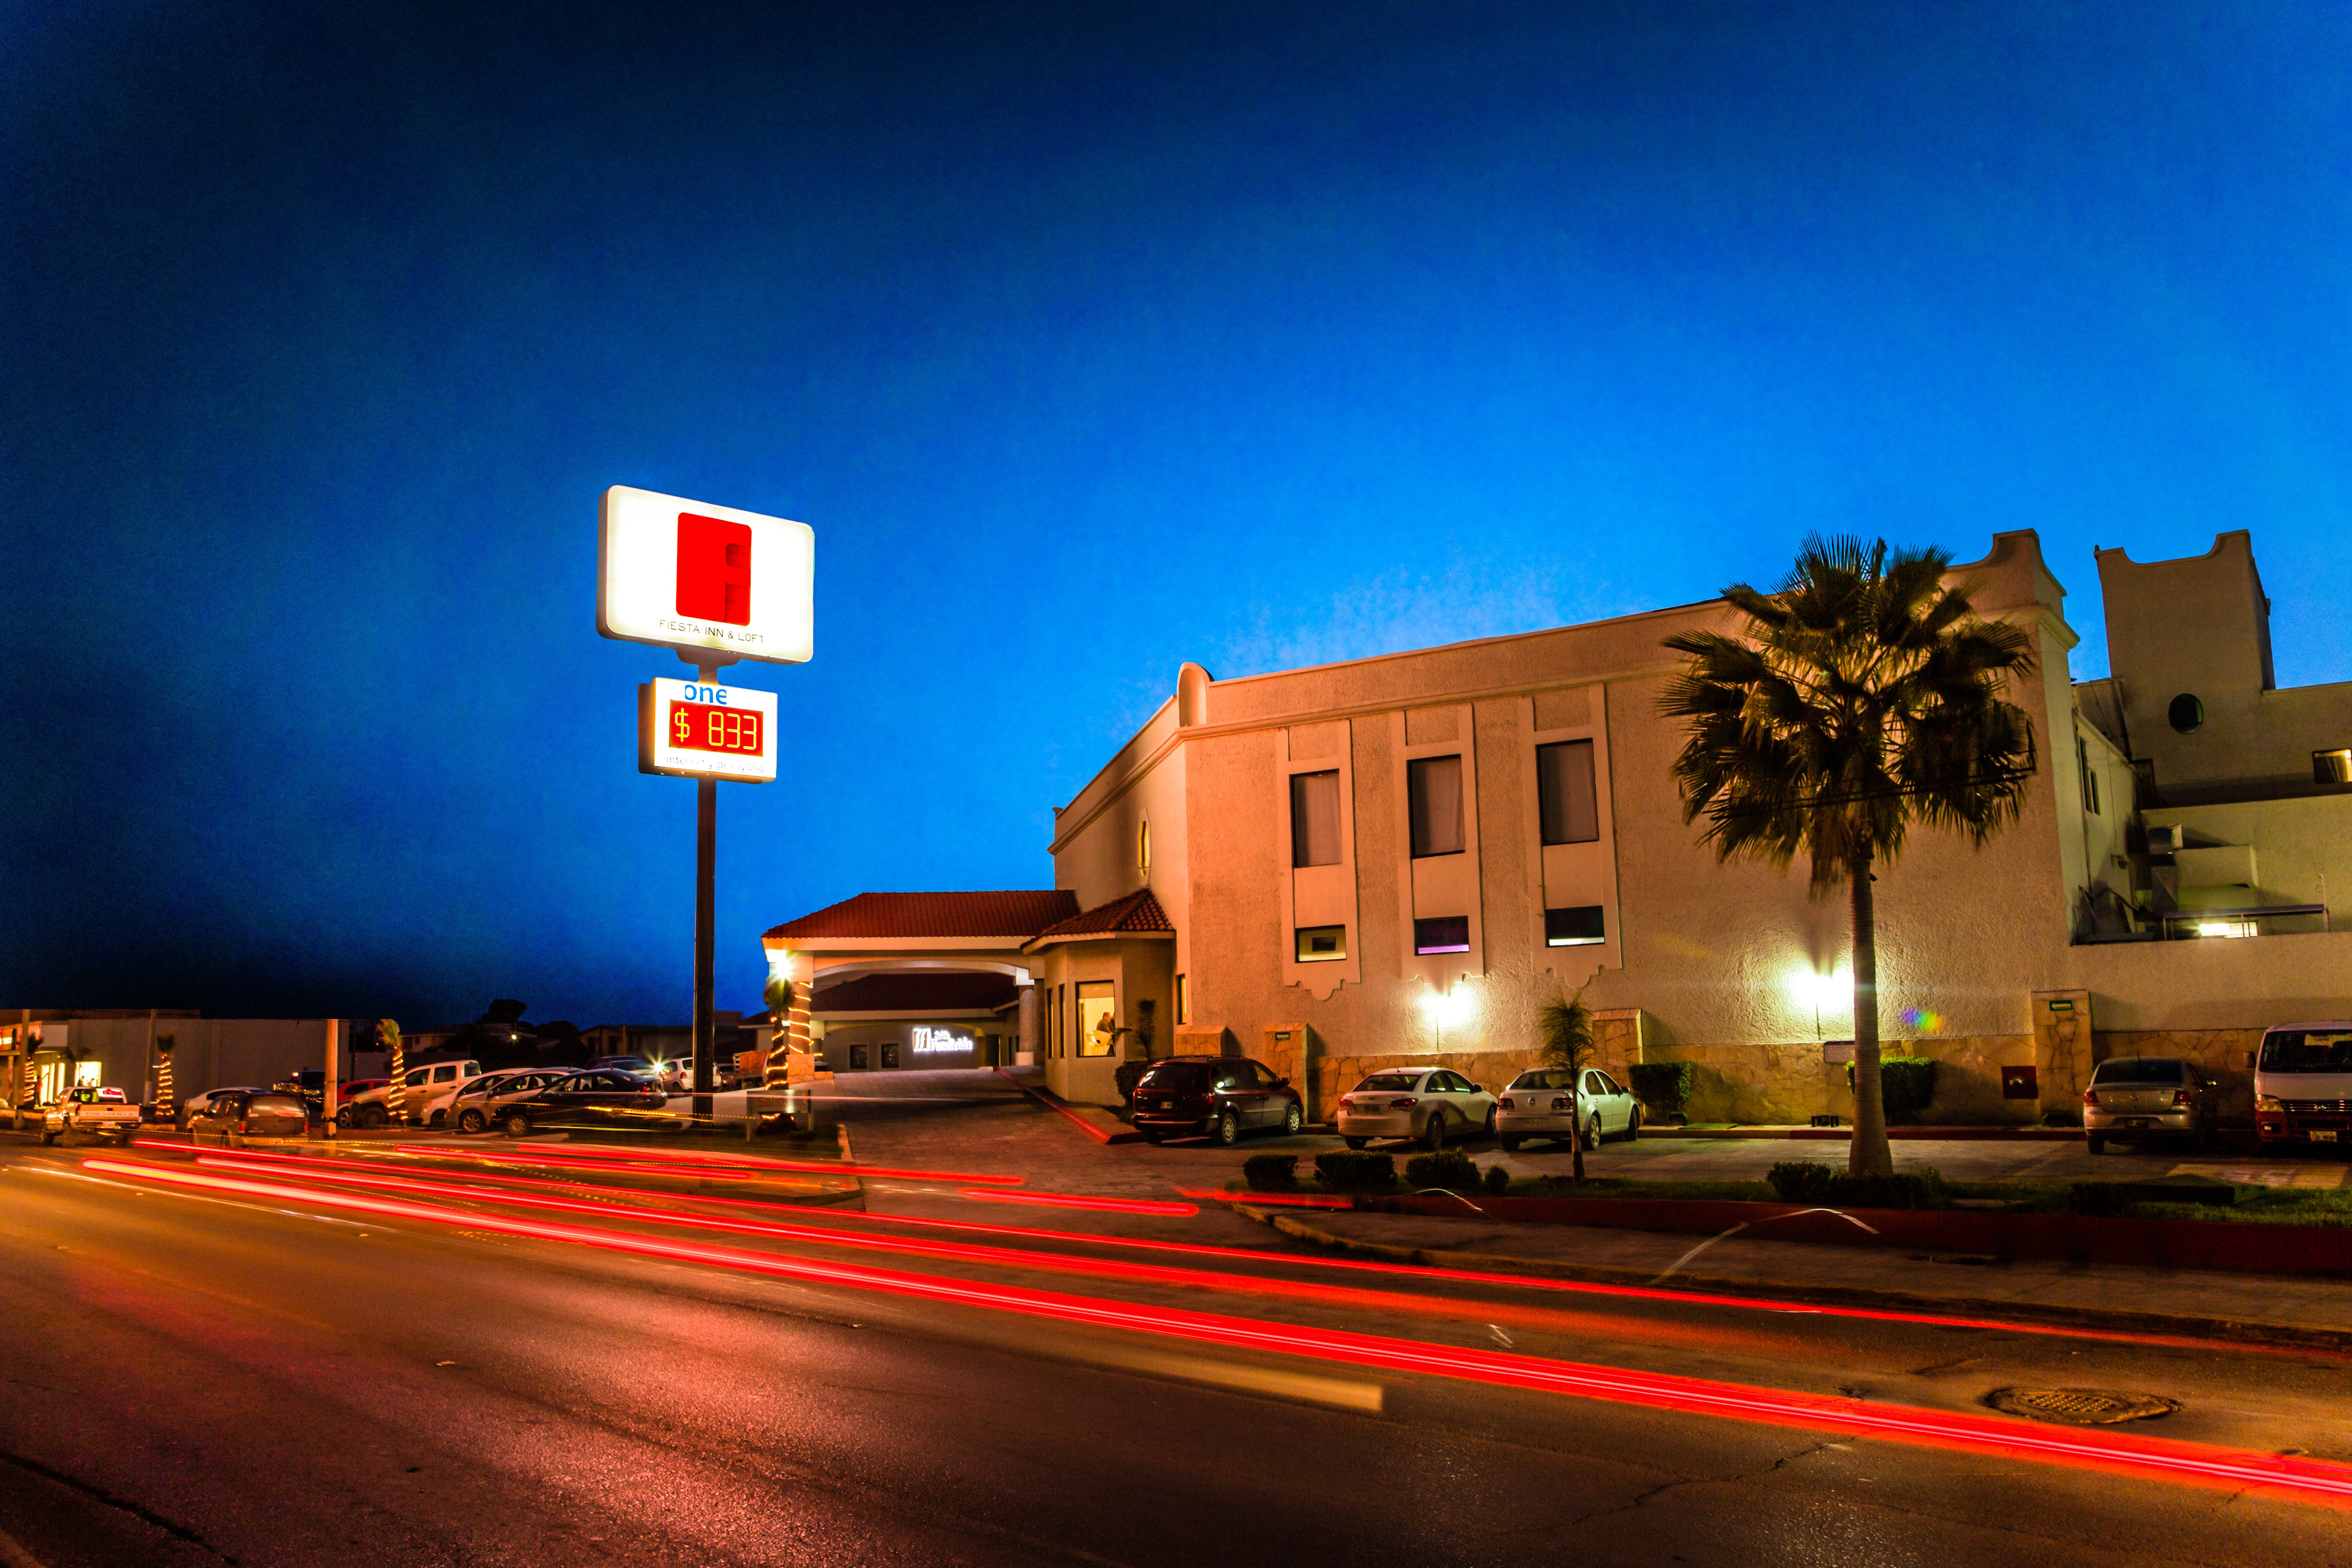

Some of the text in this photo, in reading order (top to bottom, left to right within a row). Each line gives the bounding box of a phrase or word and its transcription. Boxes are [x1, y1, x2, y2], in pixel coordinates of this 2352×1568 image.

[660, 619, 700, 634] FIESTA
[705, 627, 723, 637] INN
[738, 632, 764, 643] LOFT
[684, 684, 727, 705] one
[674, 707, 757, 750] $ 833
[757, 1096, 791, 1107] Salid
